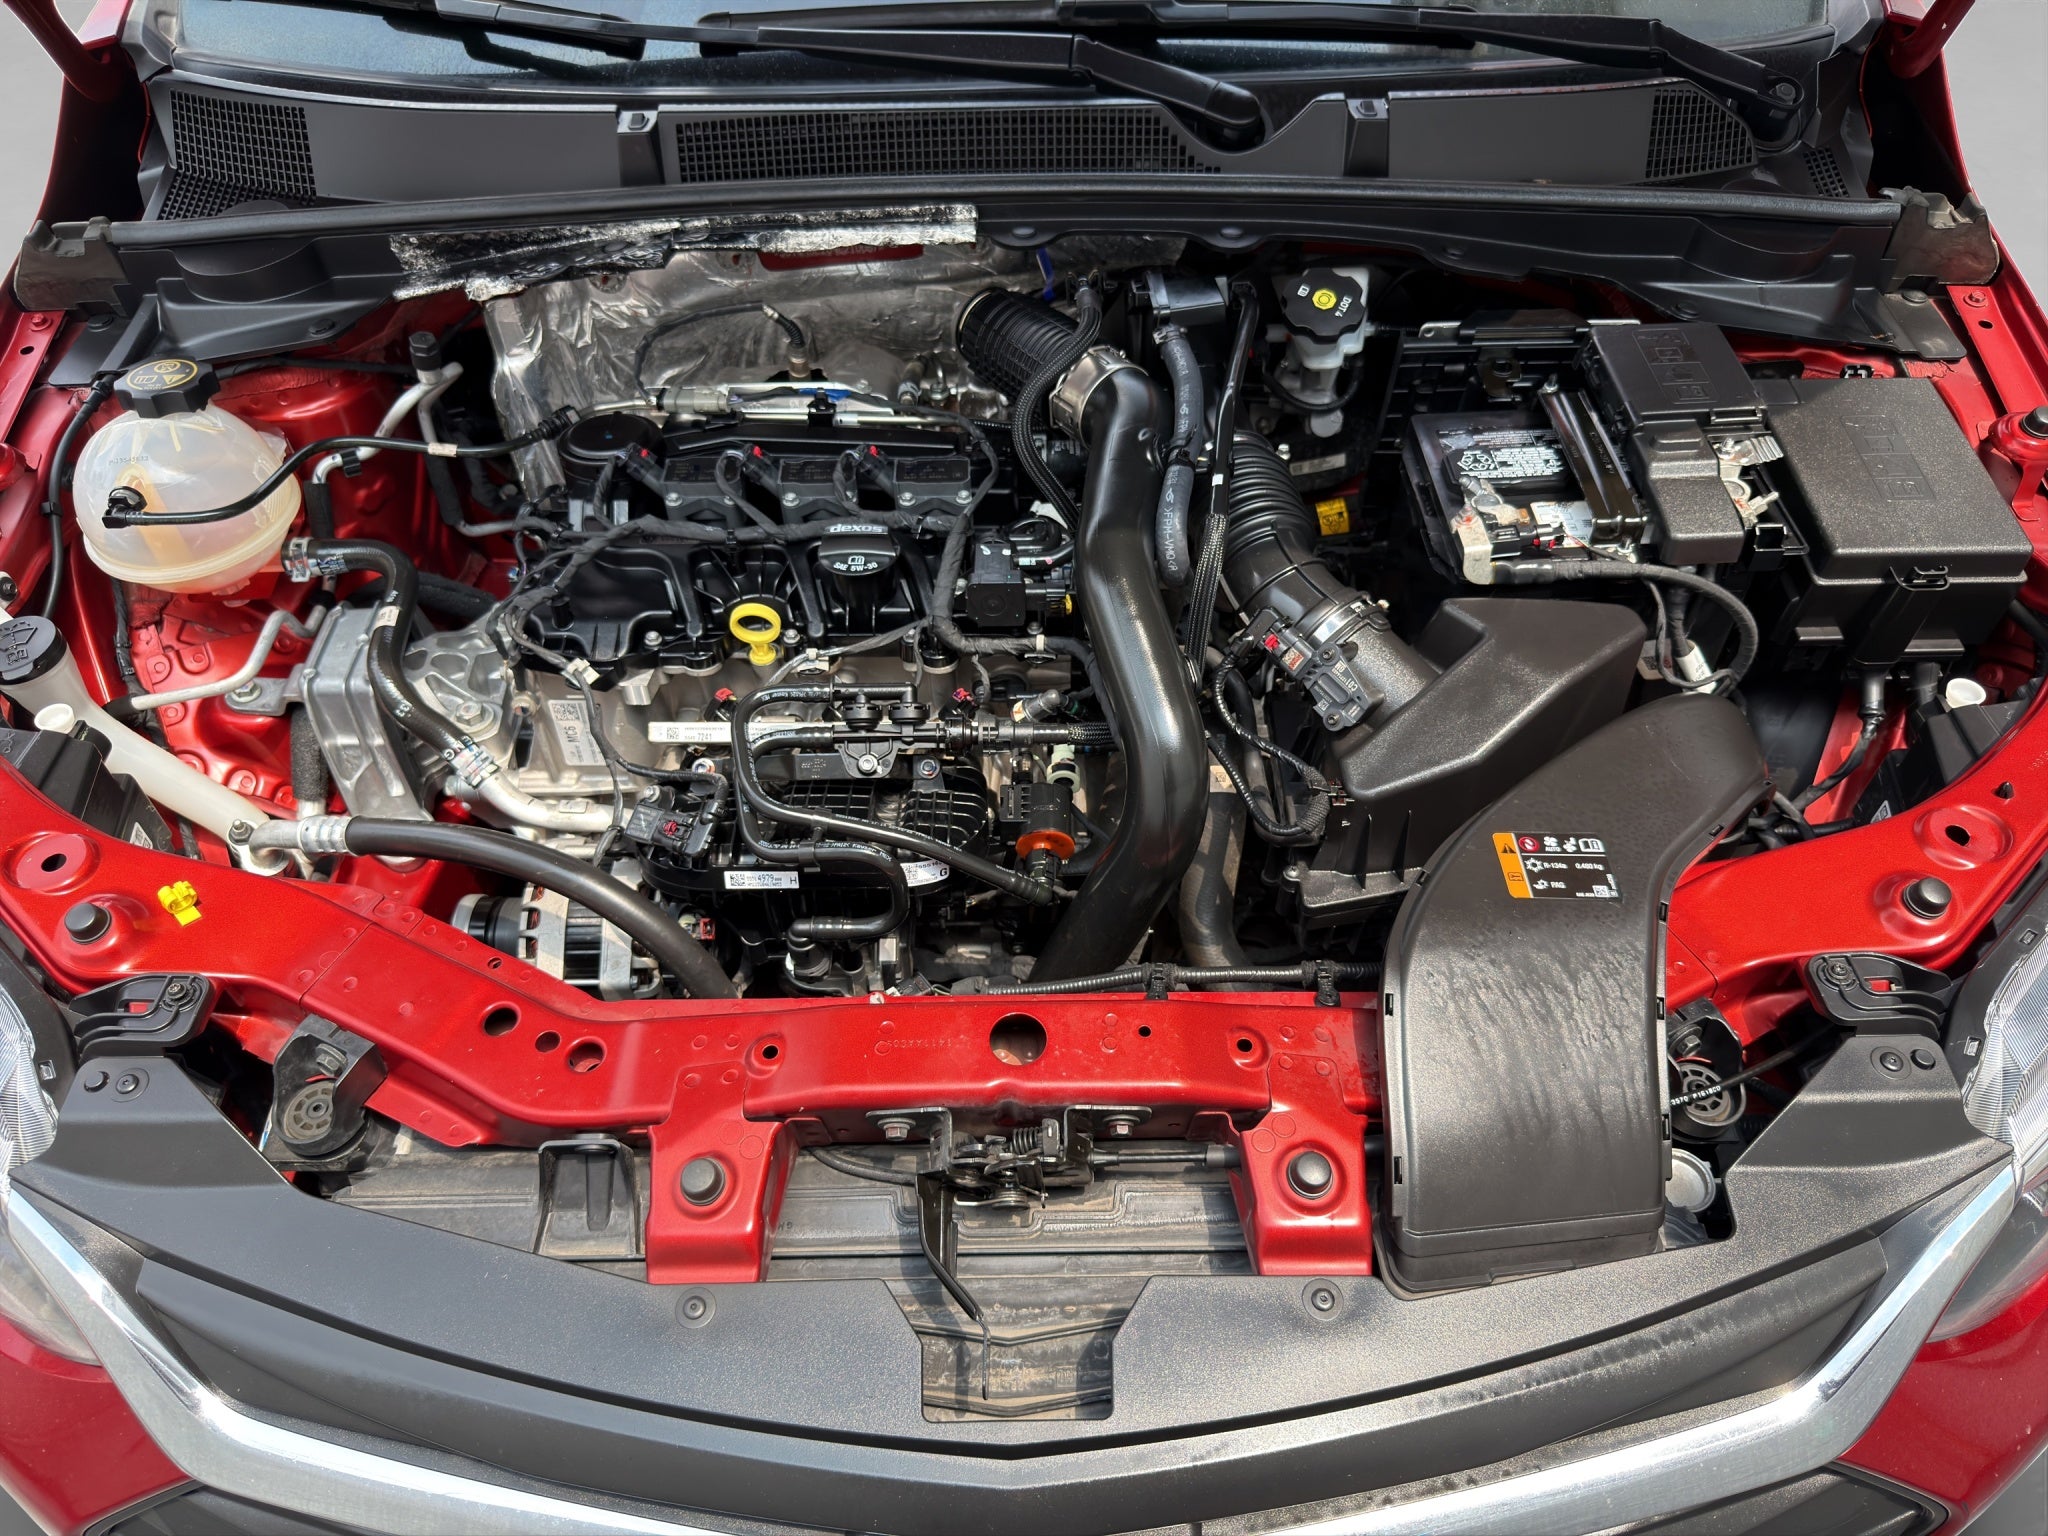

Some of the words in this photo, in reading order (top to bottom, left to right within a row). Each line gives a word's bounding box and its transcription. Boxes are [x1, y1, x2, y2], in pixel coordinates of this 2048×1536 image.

[1339, 296, 1353, 313] DOT
[829, 523, 884, 533] dexos
[833, 562, 848, 571] SAE
[850, 562, 878, 572] 5W-30
[564, 726, 581, 743] MC6
[1543, 862, 1568, 870] R-134a
[940, 868, 948, 876] G
[757, 874, 775, 883] 4979
[790, 876, 797, 884] H
